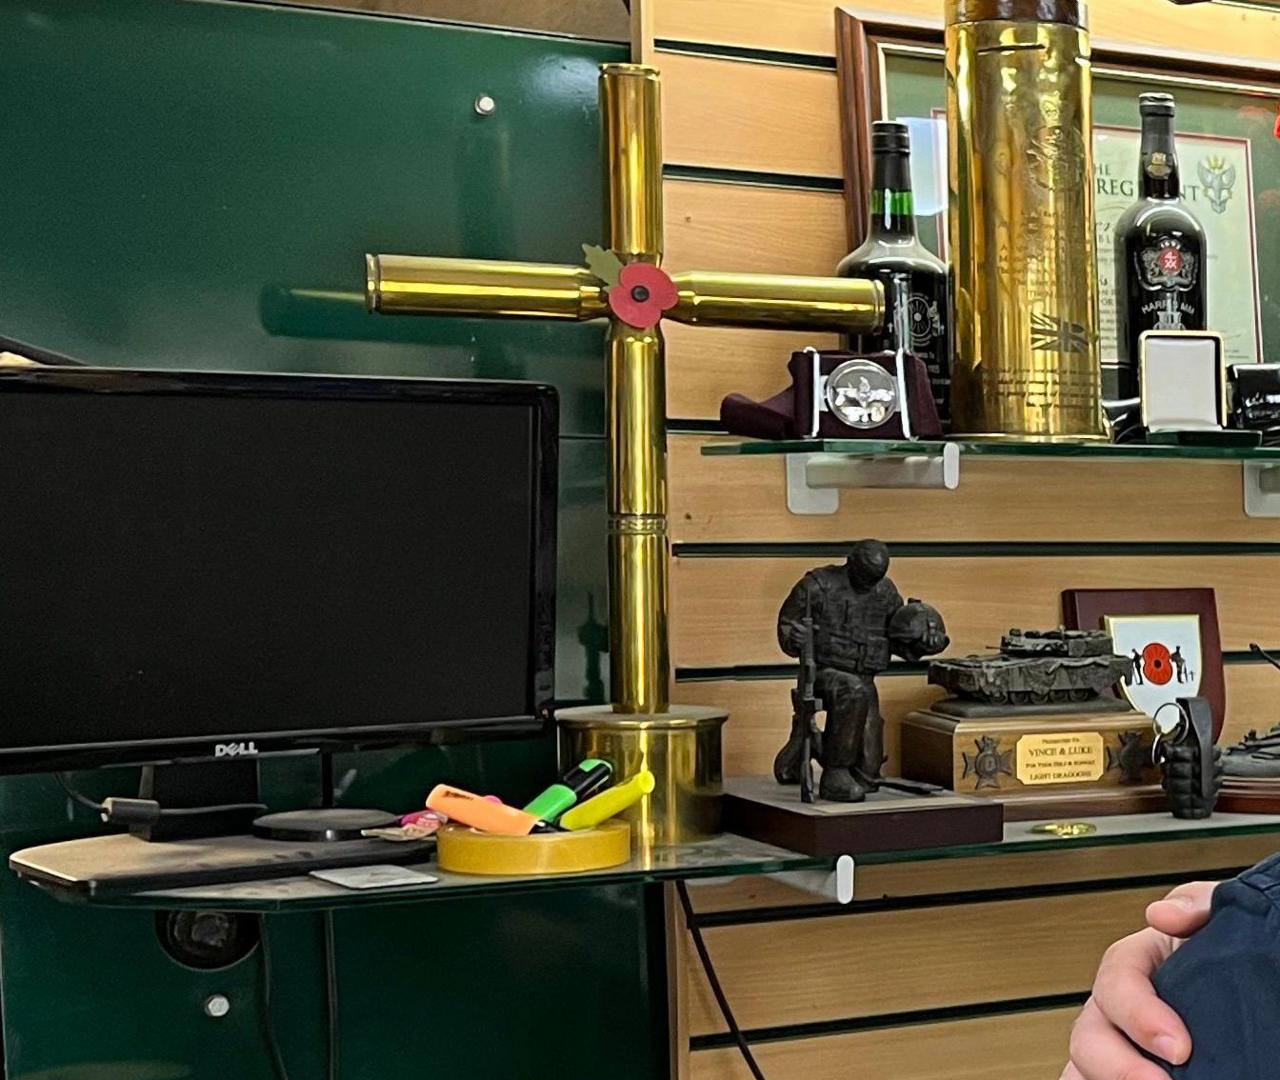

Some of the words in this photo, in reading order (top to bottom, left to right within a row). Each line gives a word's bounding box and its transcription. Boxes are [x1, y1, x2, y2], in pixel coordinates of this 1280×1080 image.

[1097, 178, 1200, 201] REGNT
[215, 741, 258, 757] DELL
[1028, 747, 1057, 757] VINCE
[1059, 747, 1066, 755] &
[1068, 745, 1093, 755] LUKE
